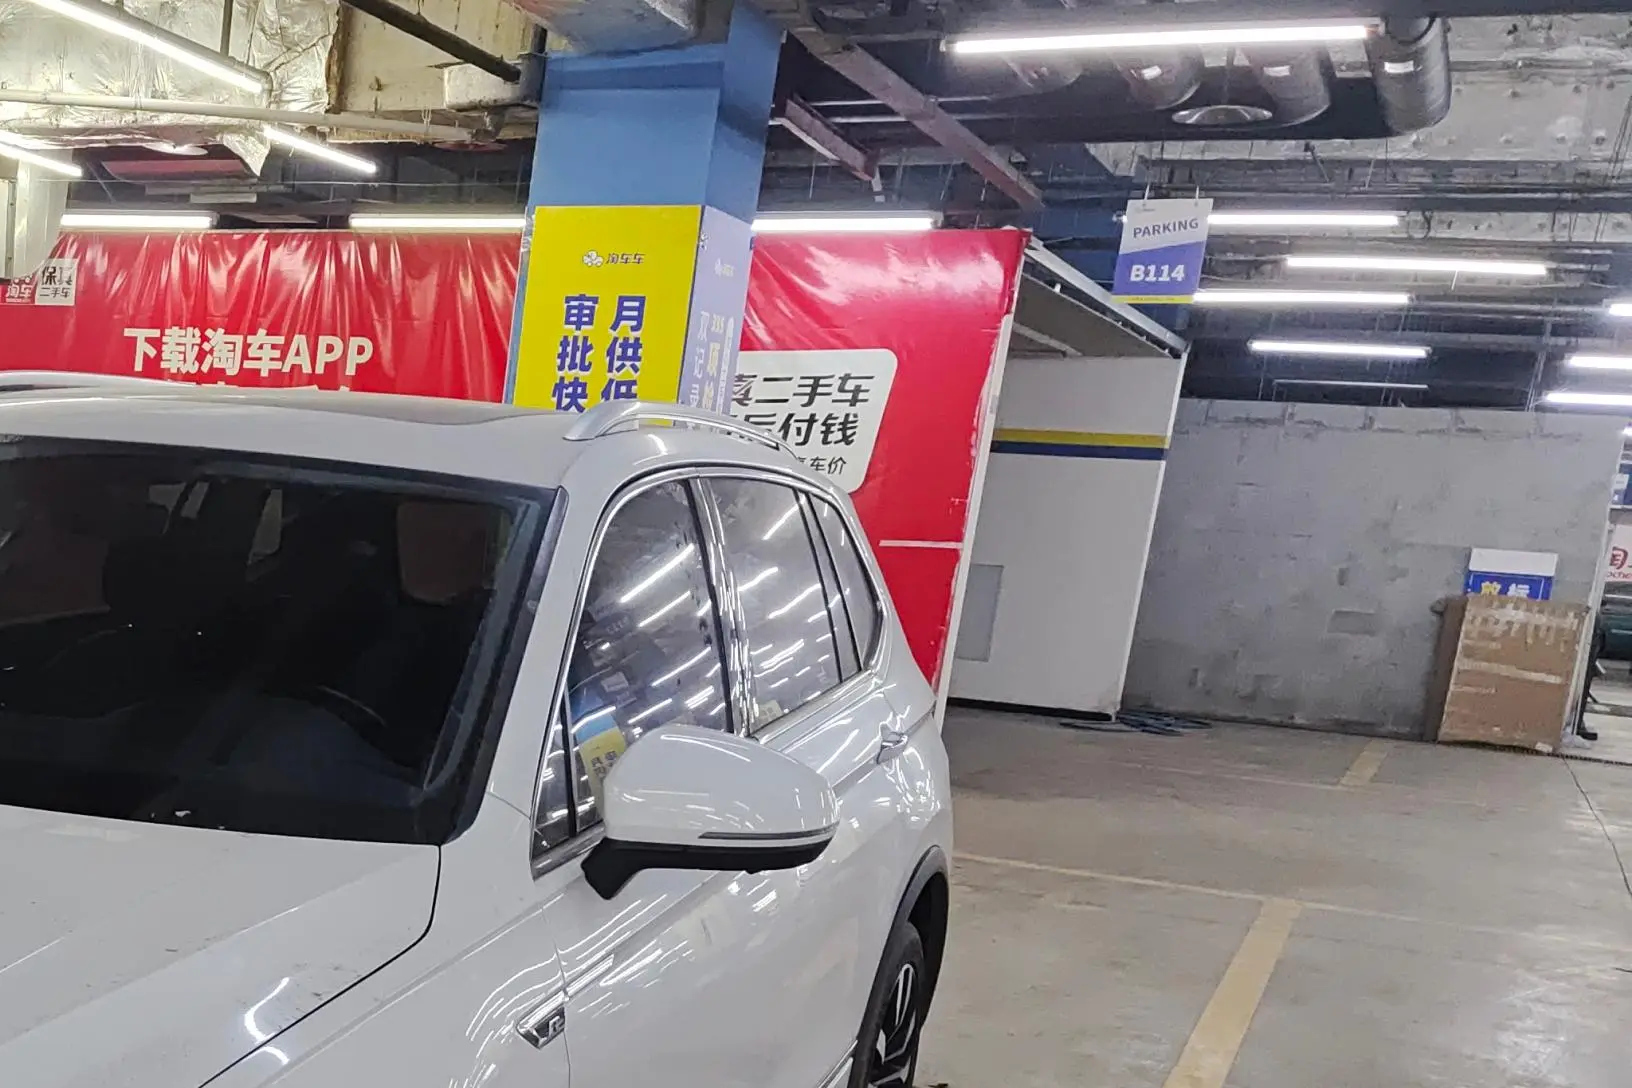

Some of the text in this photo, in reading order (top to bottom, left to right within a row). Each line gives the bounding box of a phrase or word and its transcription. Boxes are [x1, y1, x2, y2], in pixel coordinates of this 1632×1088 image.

[1133, 218, 1199, 239] PARKING
[1130, 264, 1185, 282] B114
[40, 287, 71, 298] 二手车
[123, 326, 374, 377] 下载淘车APP
[552, 294, 599, 413] 审批快
